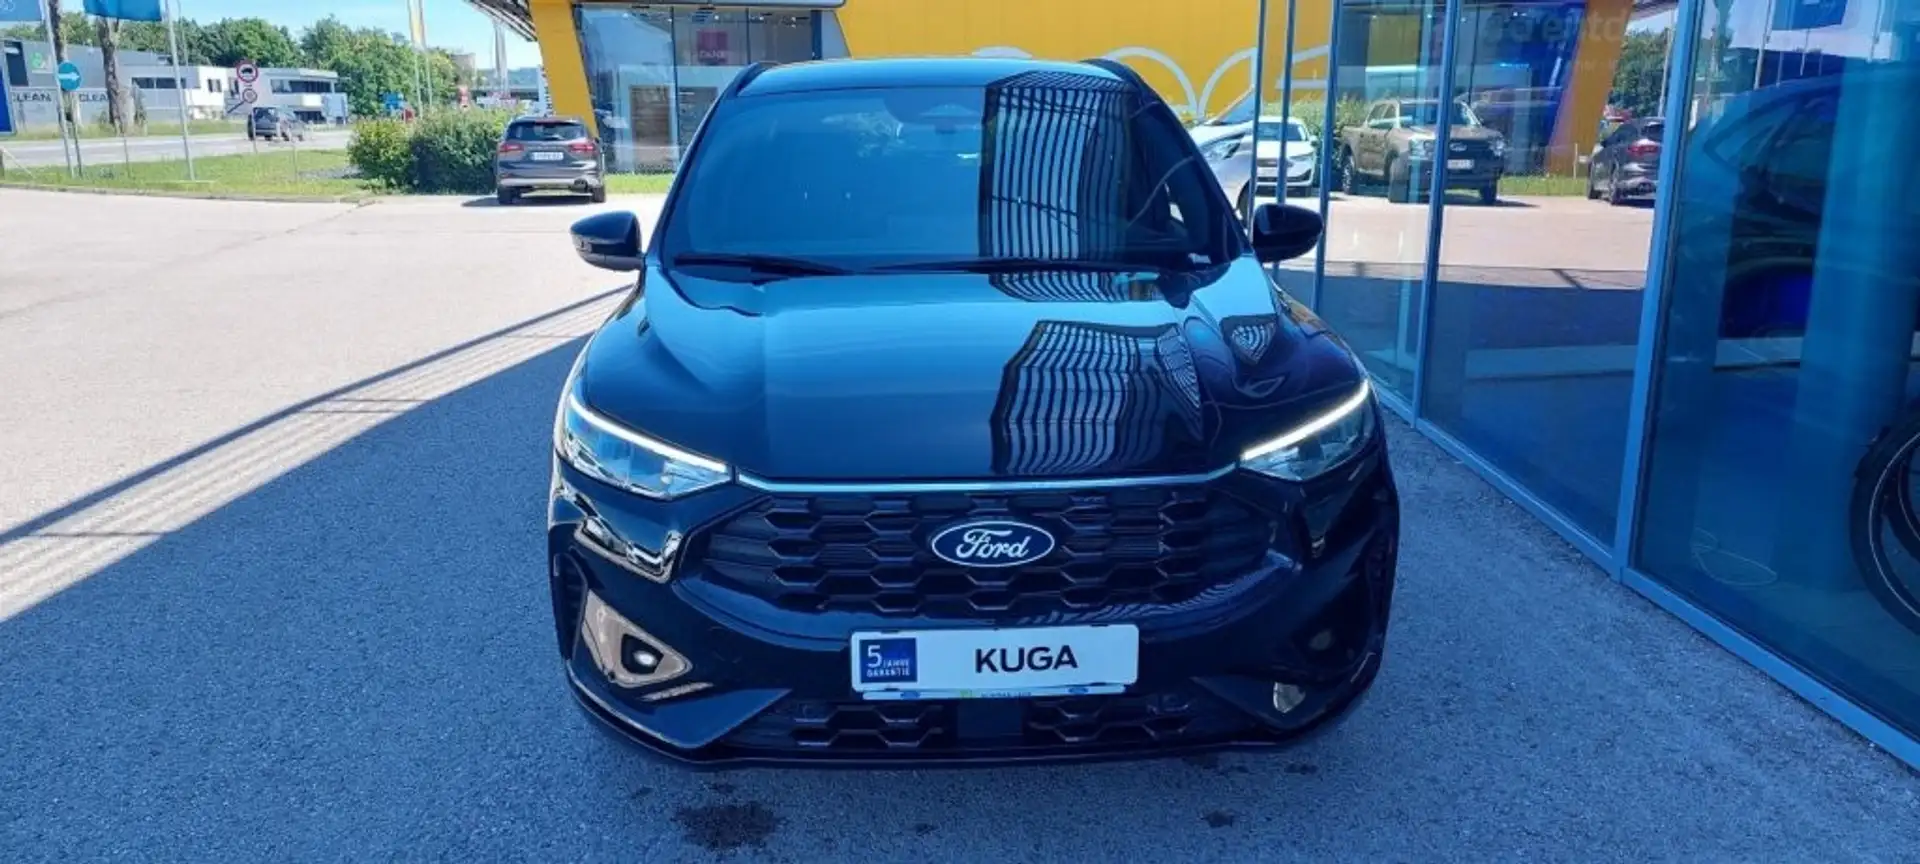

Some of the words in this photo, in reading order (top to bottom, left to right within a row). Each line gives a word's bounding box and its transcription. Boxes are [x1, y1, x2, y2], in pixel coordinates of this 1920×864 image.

[953, 528, 1031, 559] Ford
[866, 644, 882, 668] 5
[975, 645, 1079, 673] KUGA
